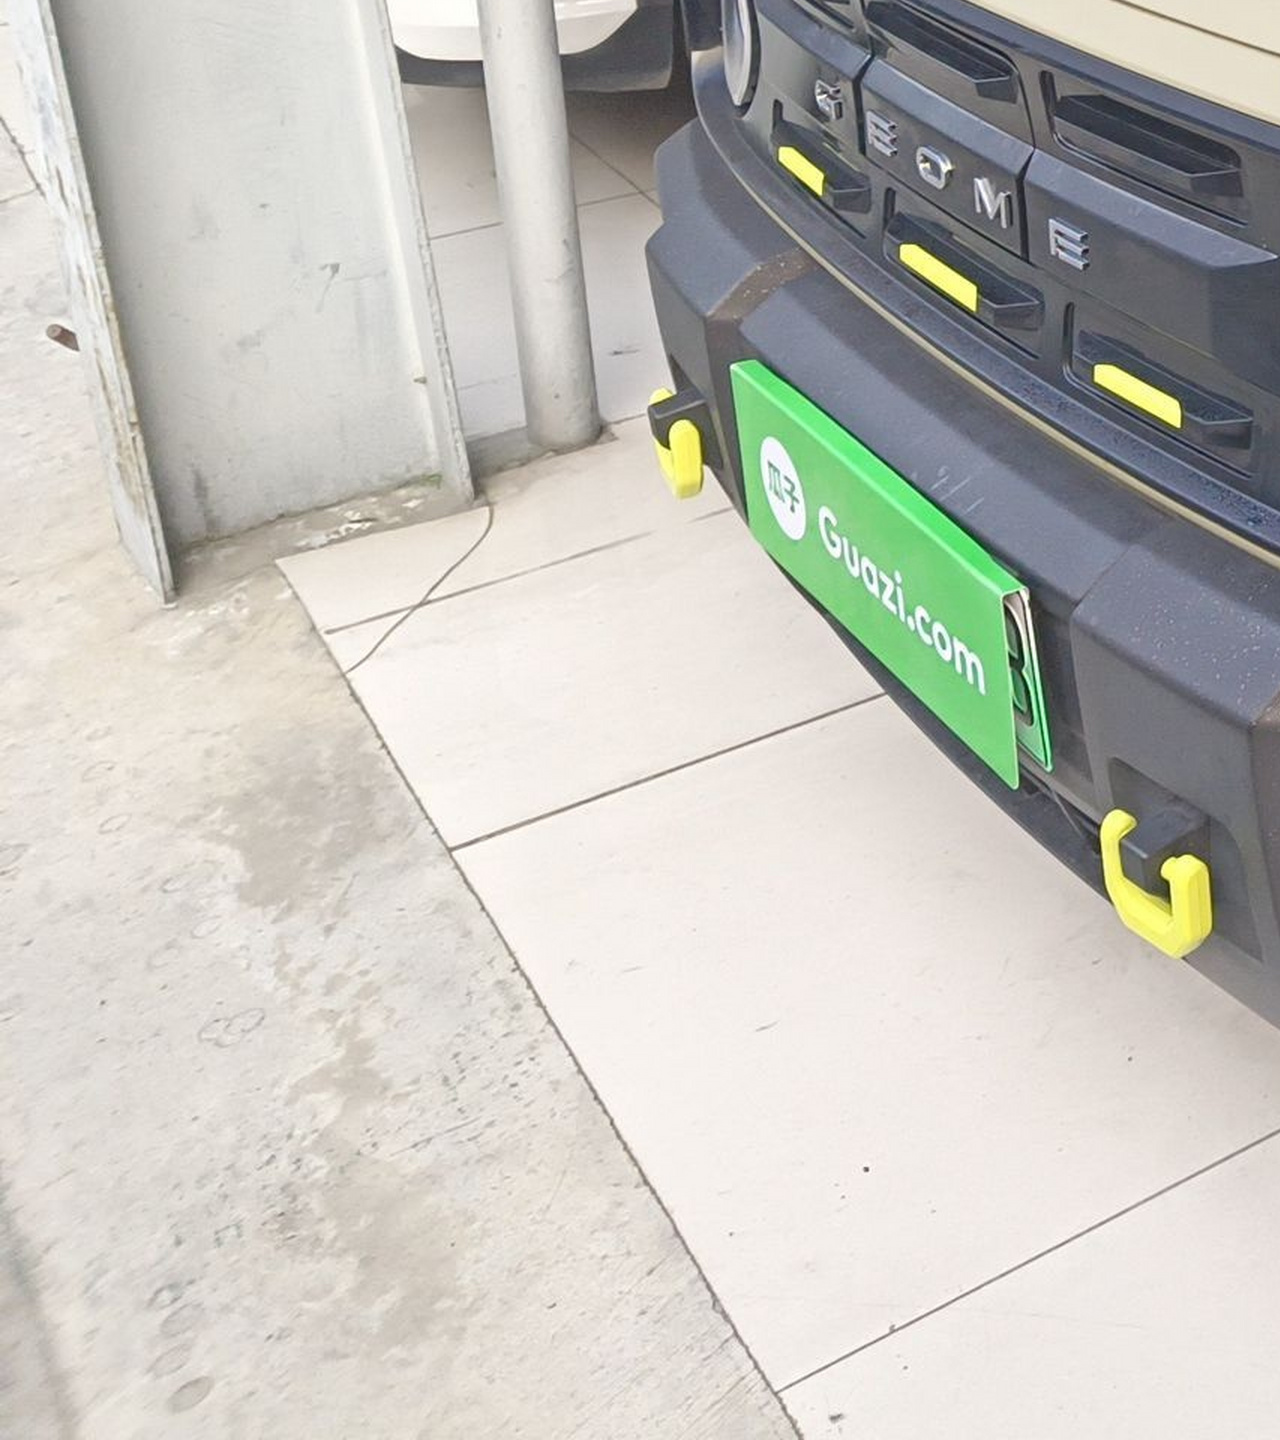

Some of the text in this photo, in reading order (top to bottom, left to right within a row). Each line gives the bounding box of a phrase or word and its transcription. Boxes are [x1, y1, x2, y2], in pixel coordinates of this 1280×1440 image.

[815, 79, 1090, 271] GEOME
[767, 458, 800, 516] 瓜子
[817, 505, 987, 697] Guazi.com
